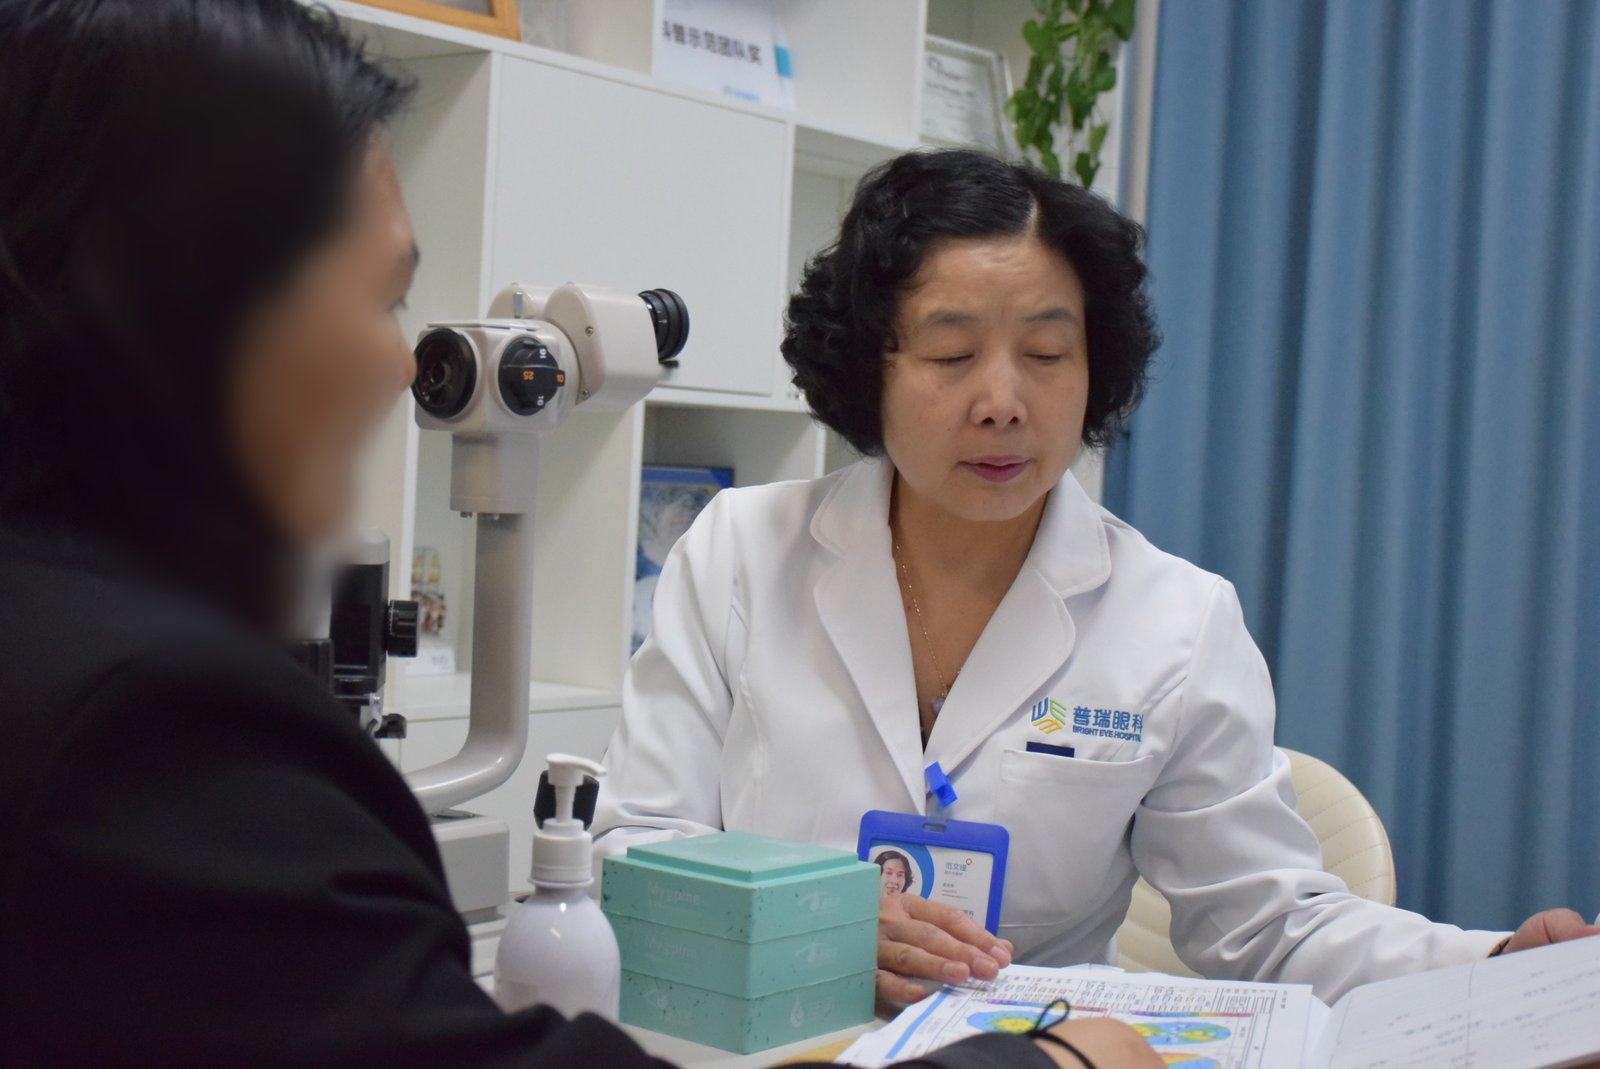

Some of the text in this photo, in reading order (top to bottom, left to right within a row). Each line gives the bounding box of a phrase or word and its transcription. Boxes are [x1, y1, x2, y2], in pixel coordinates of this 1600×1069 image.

[1072, 706, 1144, 733] 普瑞眼科
[1072, 725, 1098, 736] BRIGHT
[1099, 729, 1114, 738] EYE
